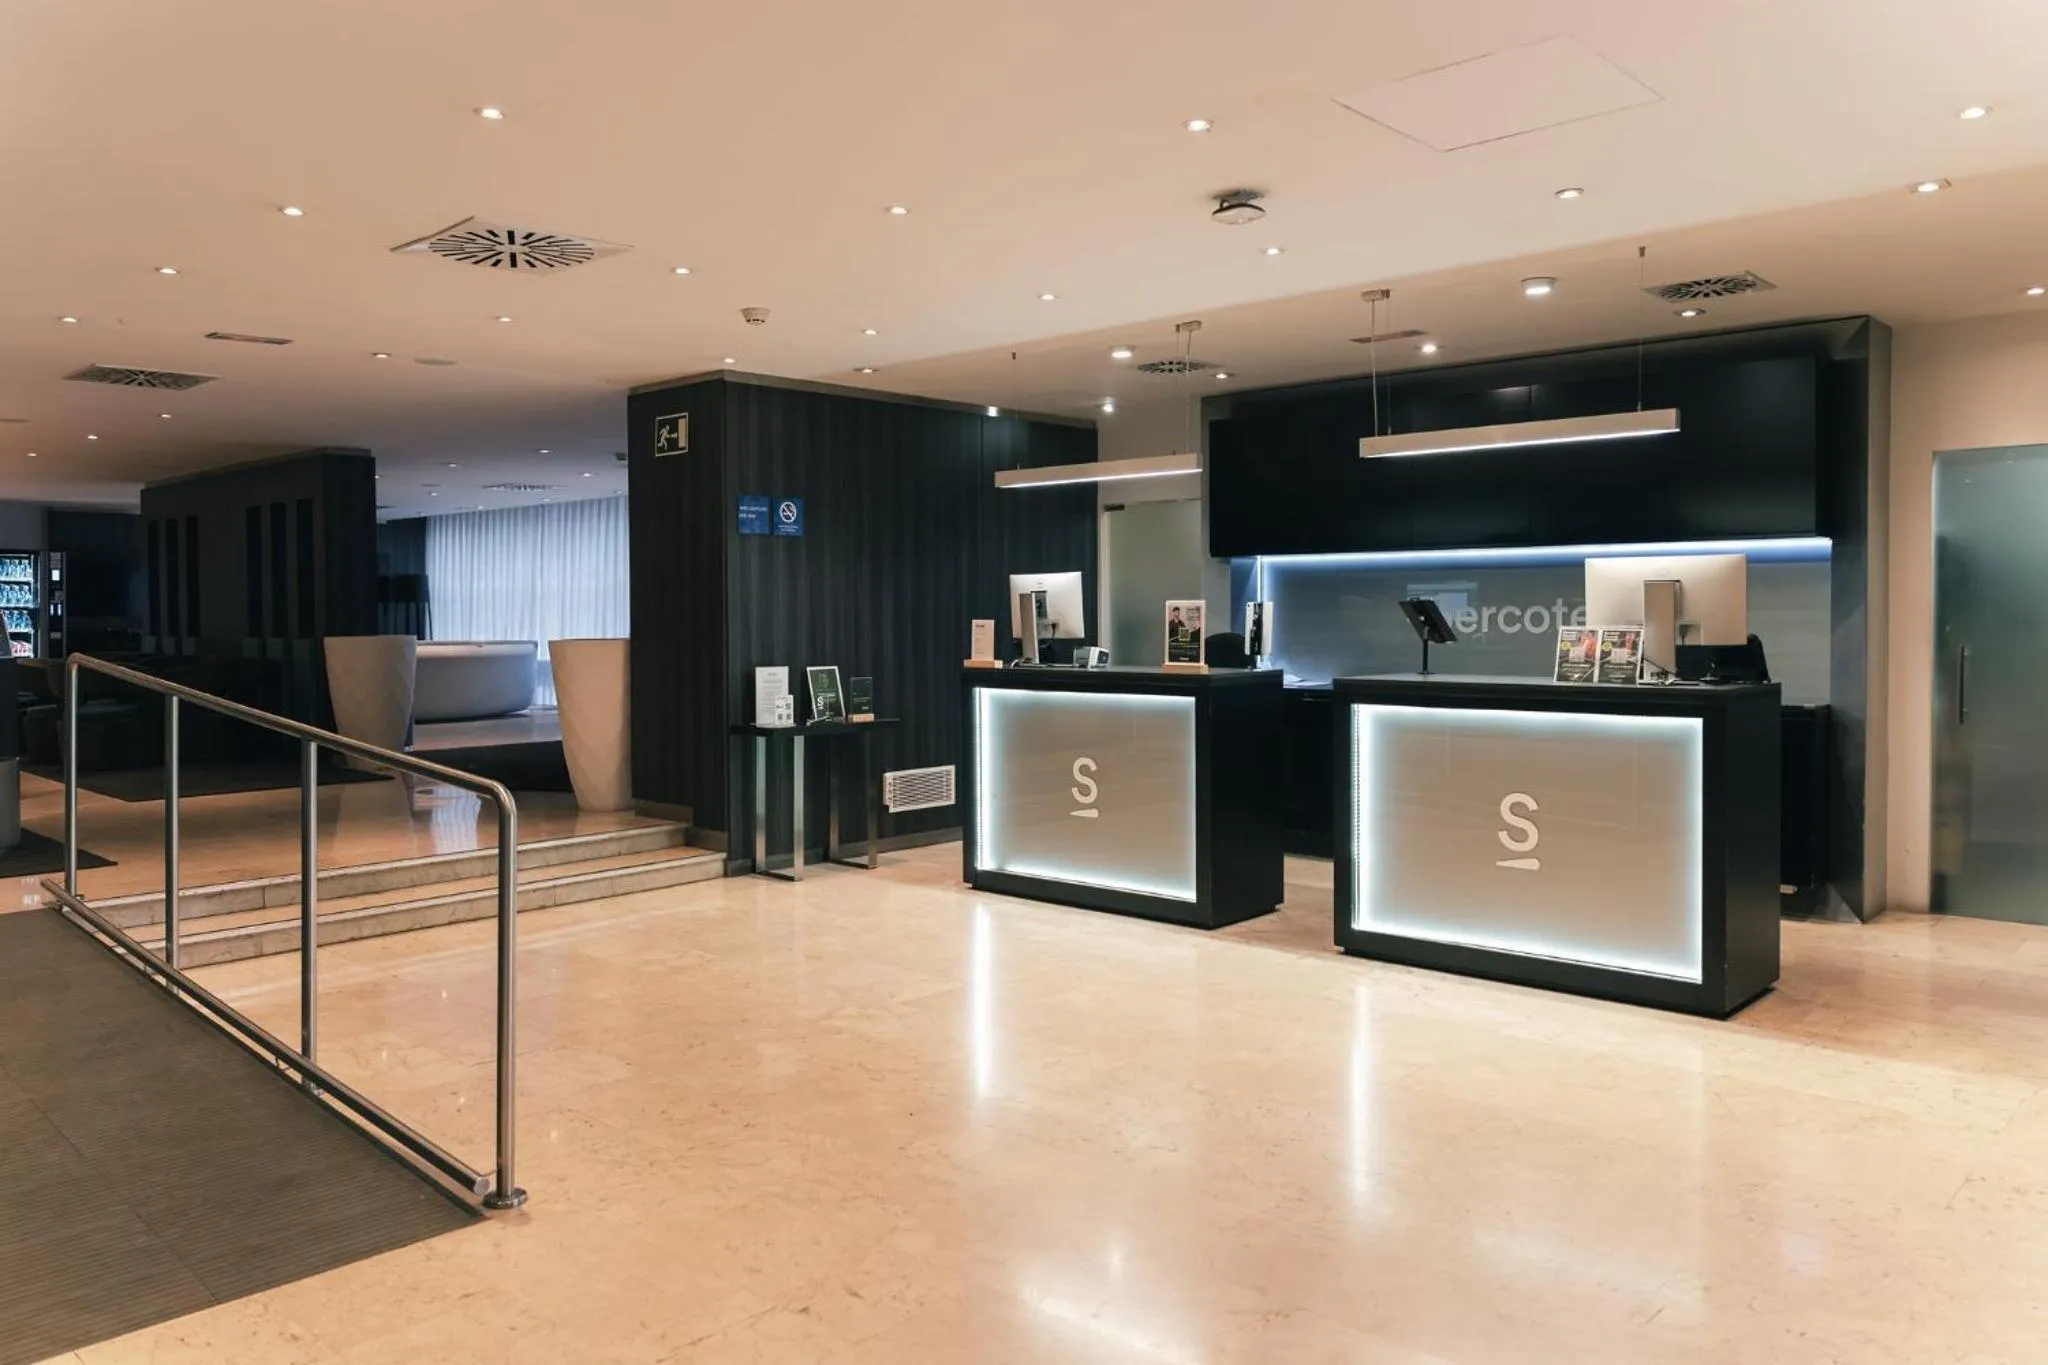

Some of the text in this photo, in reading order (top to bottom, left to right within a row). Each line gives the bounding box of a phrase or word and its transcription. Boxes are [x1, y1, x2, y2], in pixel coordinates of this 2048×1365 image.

[1449, 597, 1587, 634] ercote
[1071, 757, 1098, 804] S
[1498, 792, 1540, 852] S
